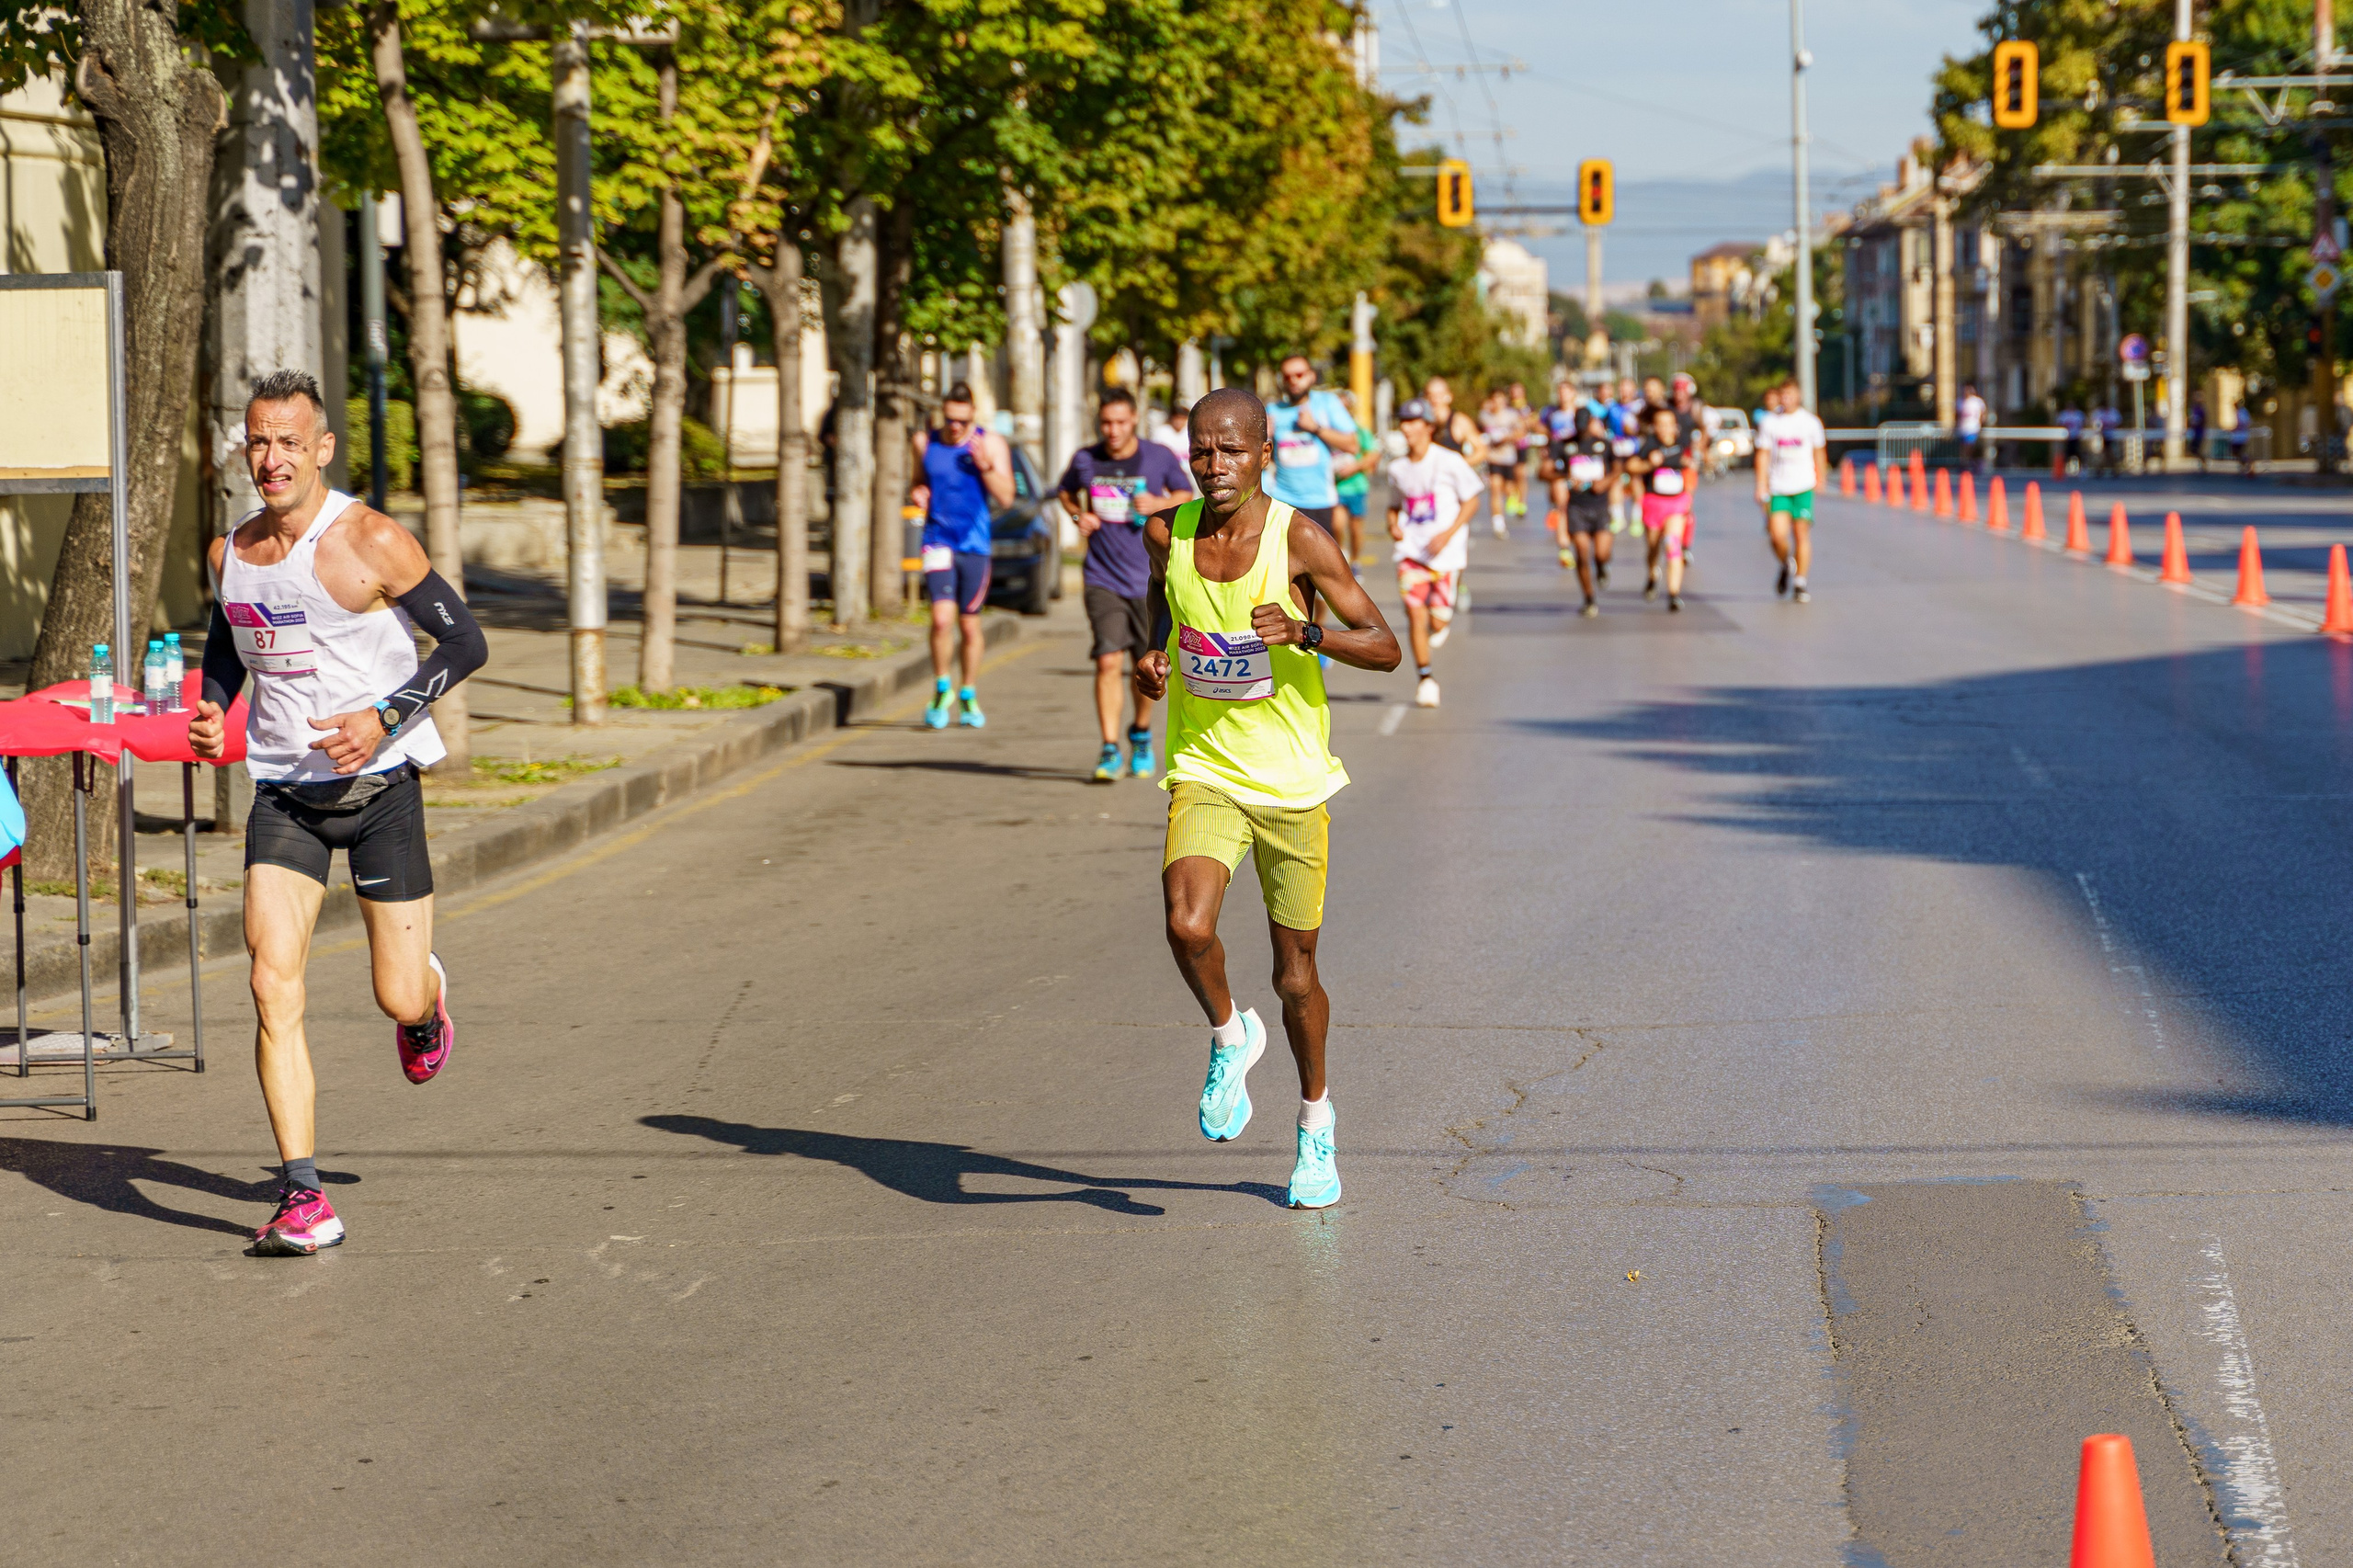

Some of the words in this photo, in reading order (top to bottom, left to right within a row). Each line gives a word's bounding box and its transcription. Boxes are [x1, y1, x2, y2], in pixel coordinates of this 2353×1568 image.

[434, 601, 455, 625] 2XU
[254, 630, 276, 650] 87
[1190, 655, 1252, 677] 2472
